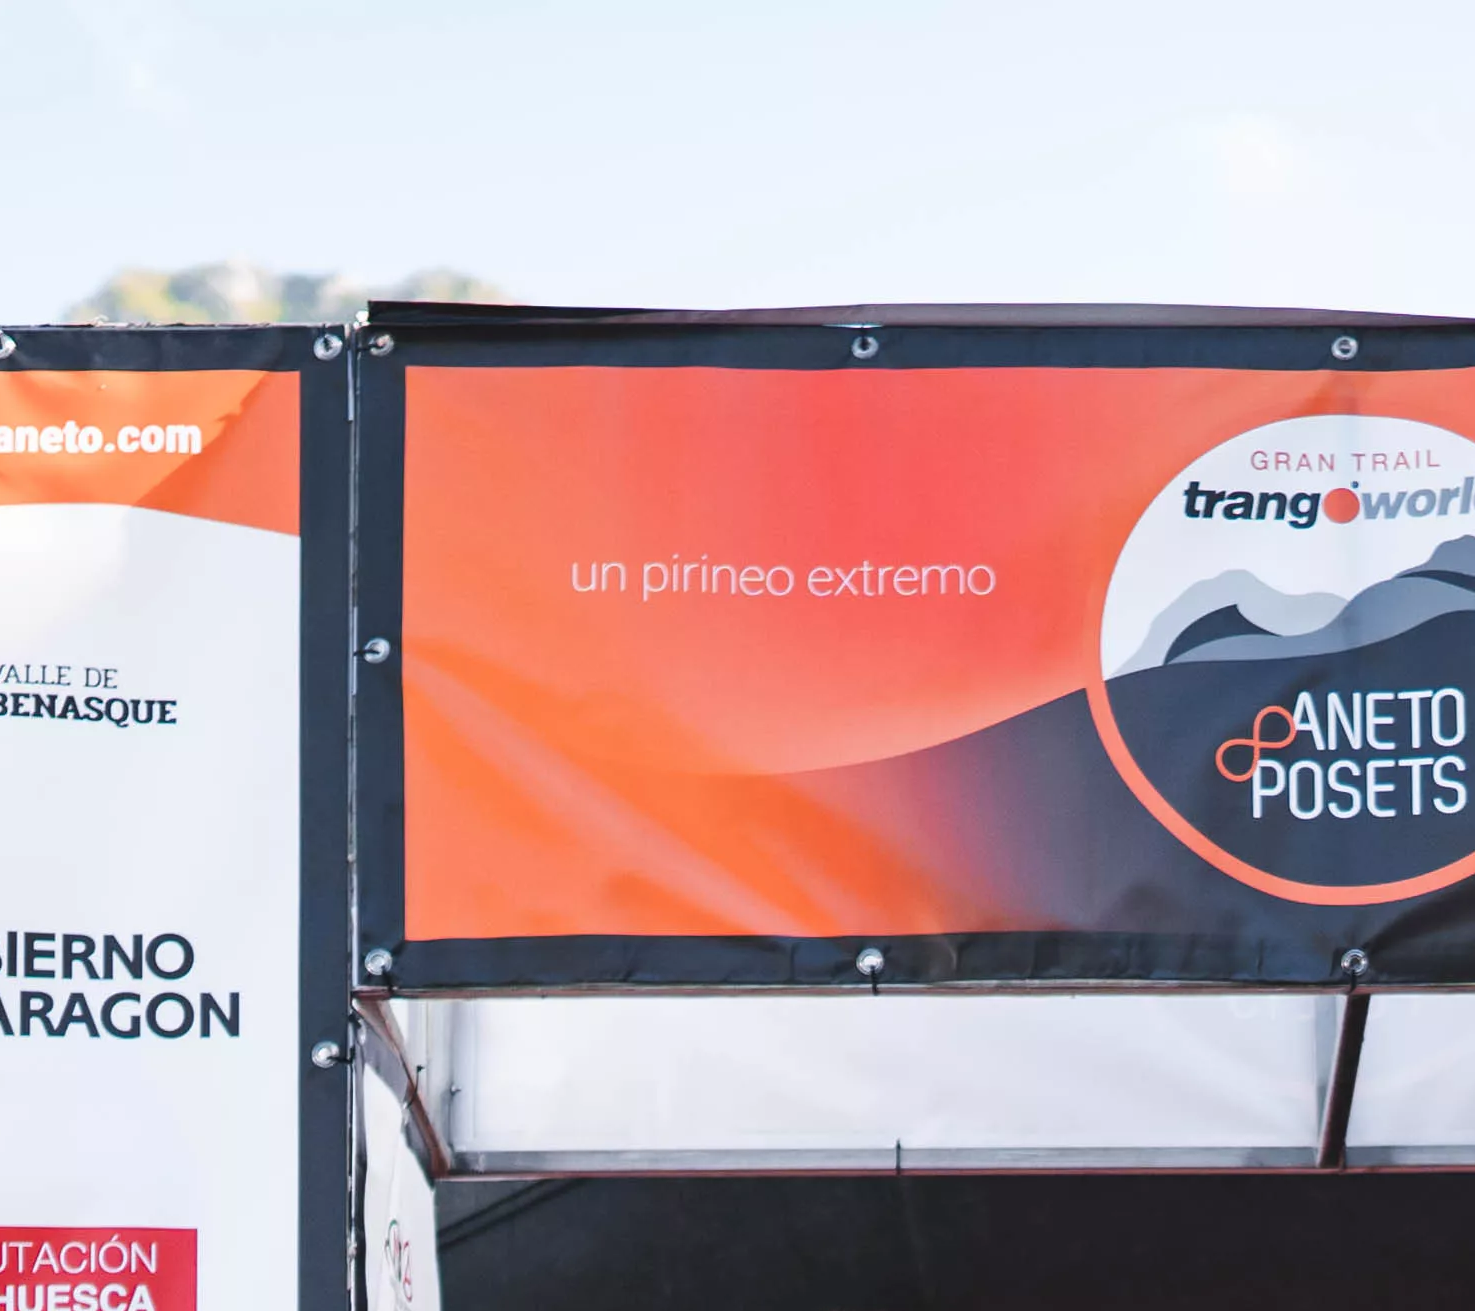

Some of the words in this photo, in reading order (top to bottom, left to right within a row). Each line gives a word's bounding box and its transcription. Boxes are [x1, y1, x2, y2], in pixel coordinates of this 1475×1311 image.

[1250, 450, 1335, 472] GRAN
[1352, 448, 1441, 470] TRAIL
[571, 559, 626, 593] un
[642, 553, 794, 602] pirineo
[807, 560, 996, 597] extremo
[84, 666, 118, 689] DE
[1290, 687, 1465, 752] ANETO
[1251, 755, 1468, 820] POSETS
